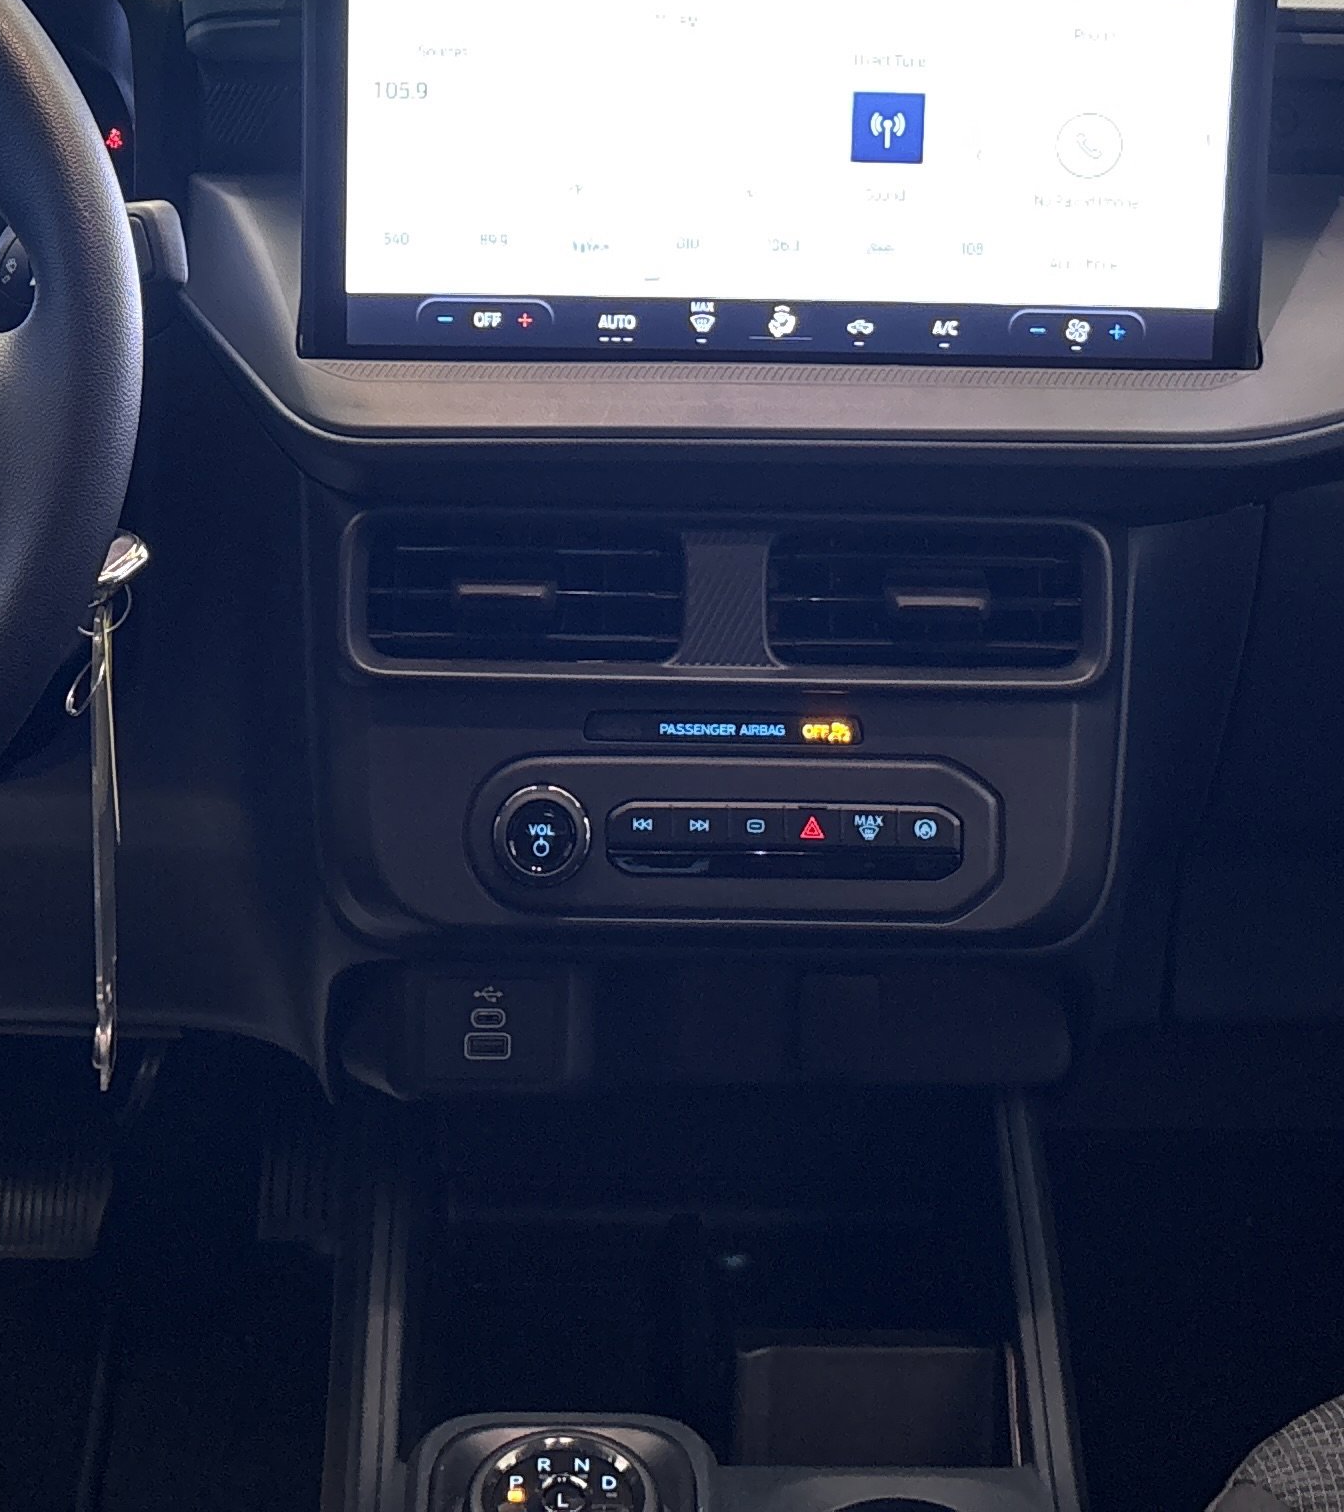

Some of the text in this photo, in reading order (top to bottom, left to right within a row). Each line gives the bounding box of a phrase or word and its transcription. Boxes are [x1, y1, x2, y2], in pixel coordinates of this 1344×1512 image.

[374, 82, 429, 100] 105.9
[690, 301, 714, 314] MAX
[473, 312, 502, 328] OFF
[598, 314, 636, 330] AUTO
[932, 320, 959, 337] A/C
[659, 723, 830, 739] PASSENGER AIRBAG OFF
[854, 815, 884, 827] MAX
[528, 823, 554, 837] VOL
[509, 1457, 617, 1490] P R N D
[557, 1493, 569, 1508] L
